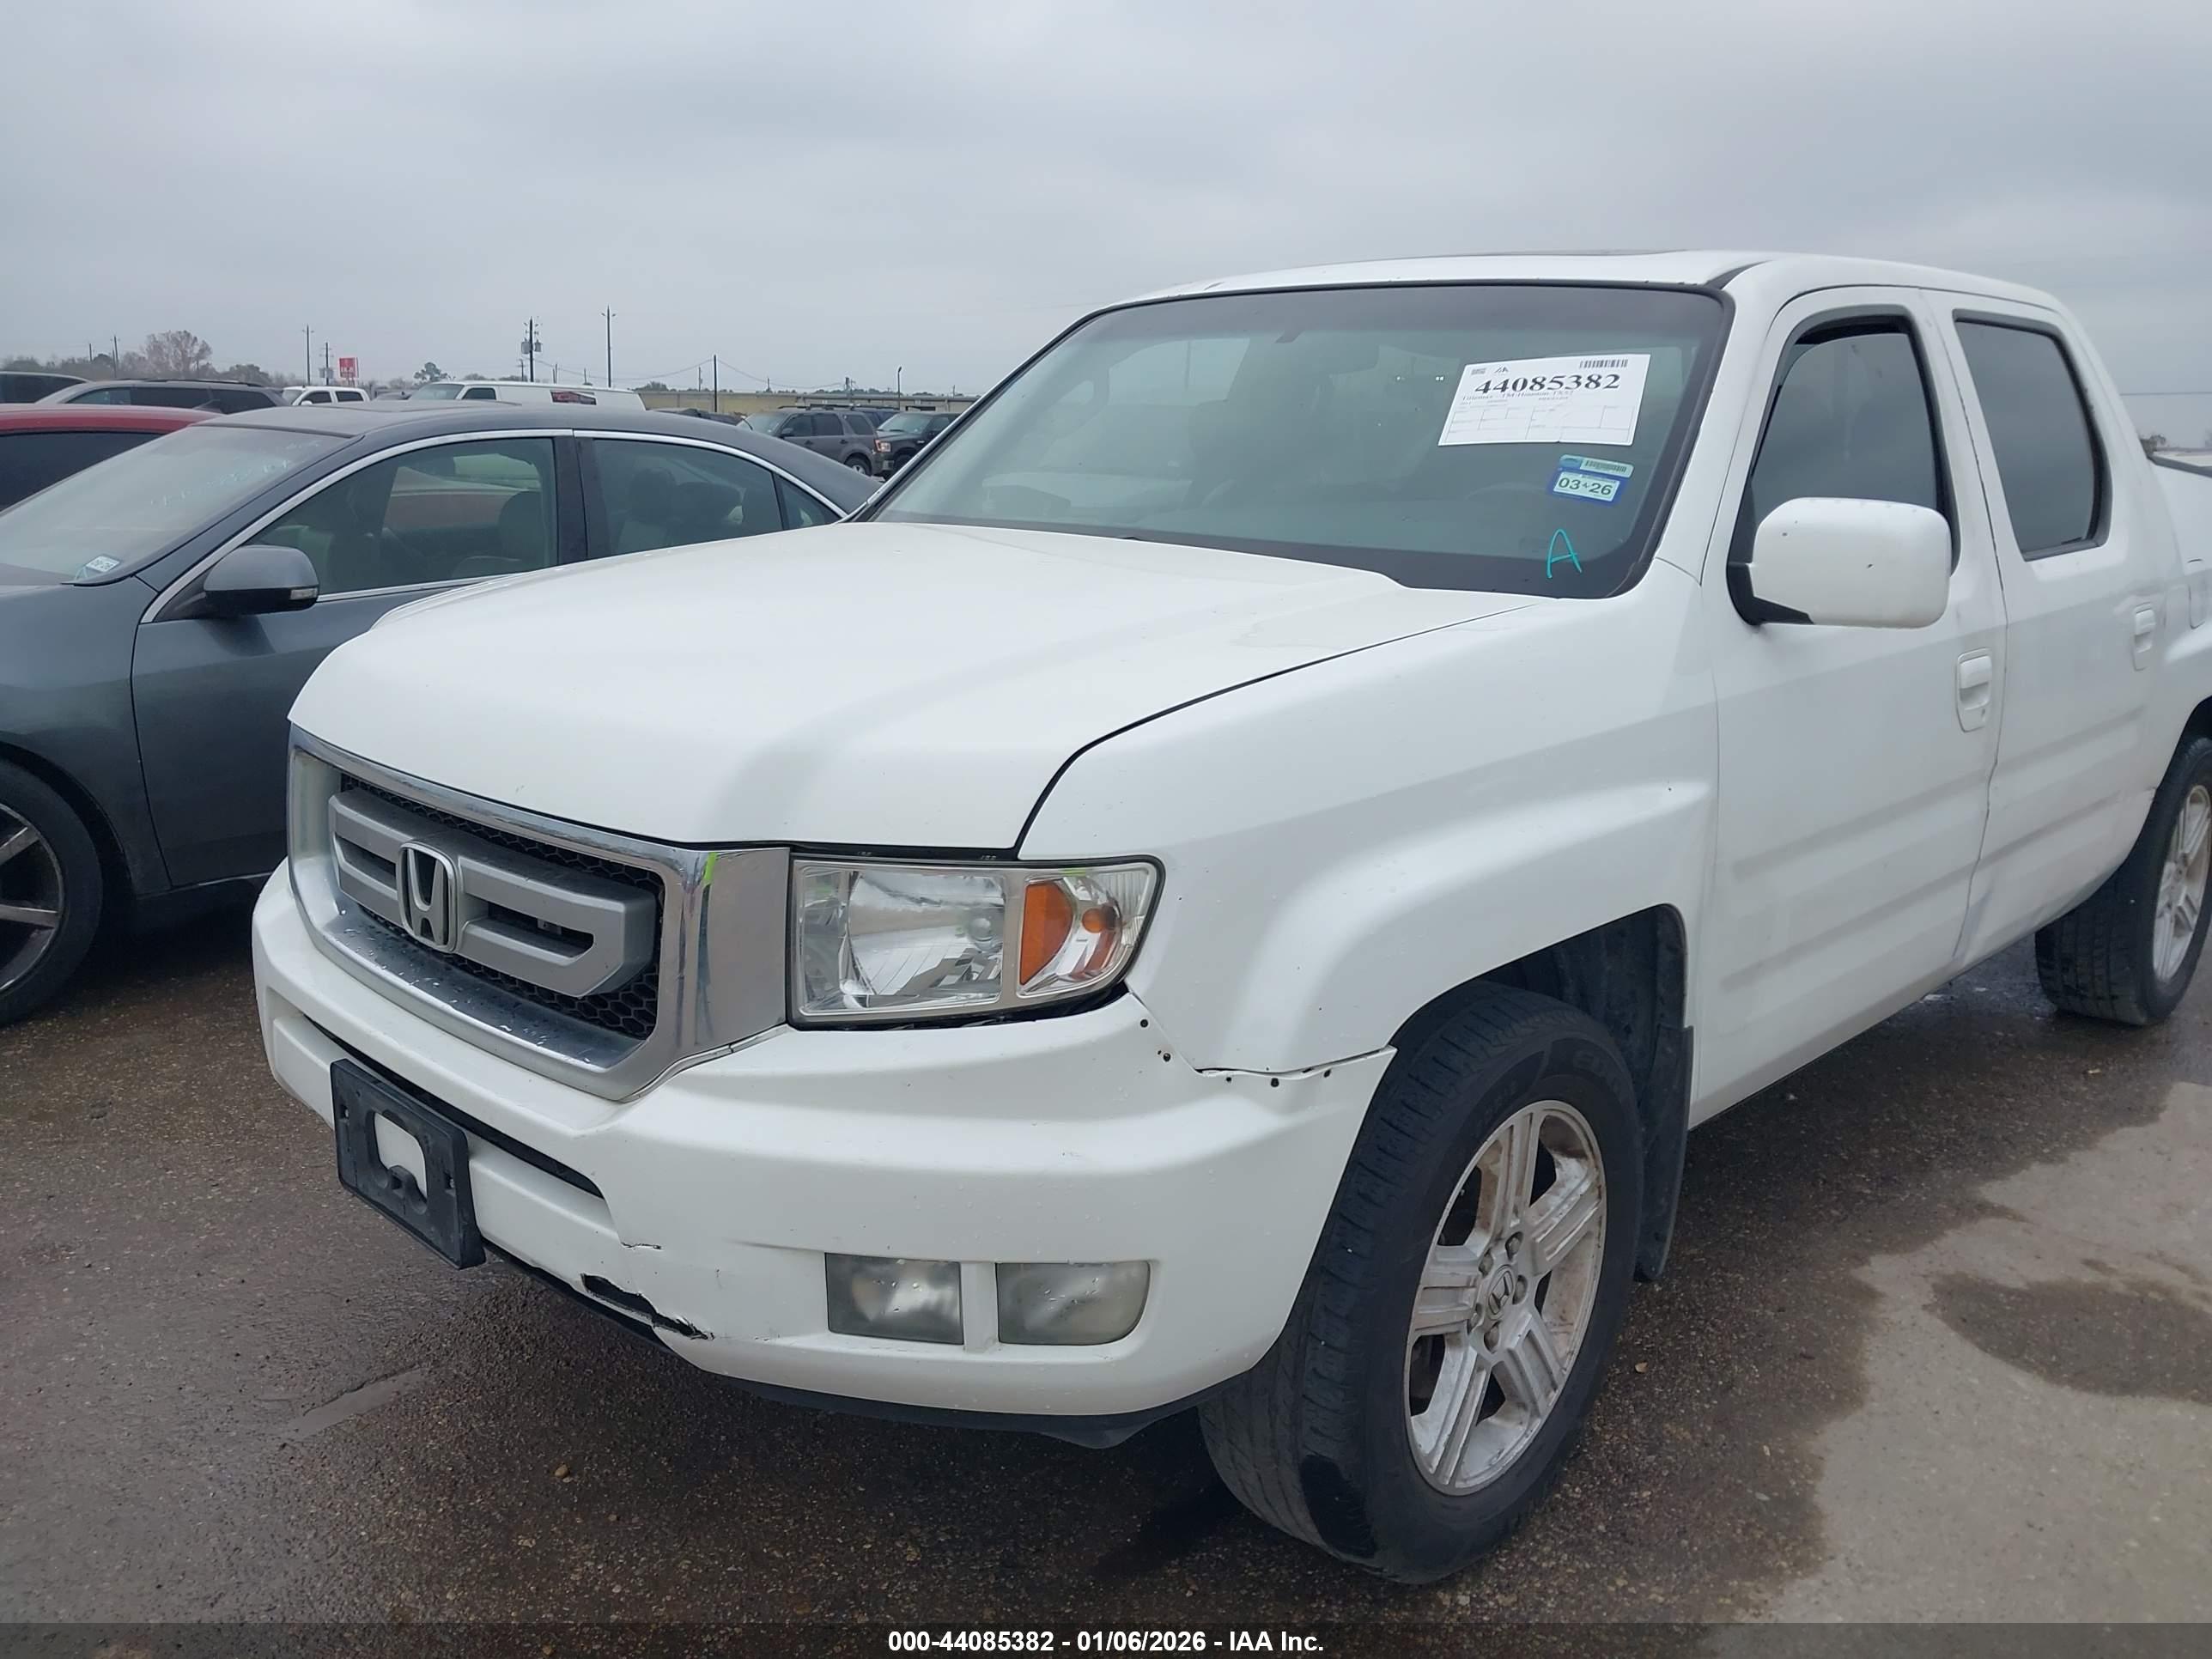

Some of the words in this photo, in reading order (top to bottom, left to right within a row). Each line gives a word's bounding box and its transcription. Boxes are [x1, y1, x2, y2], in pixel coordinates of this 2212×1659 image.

[1474, 374, 1620, 393] 44085382
[1559, 477, 1581, 490] 03
[1589, 483, 1613, 495] 26
[1547, 529, 1583, 579] A
